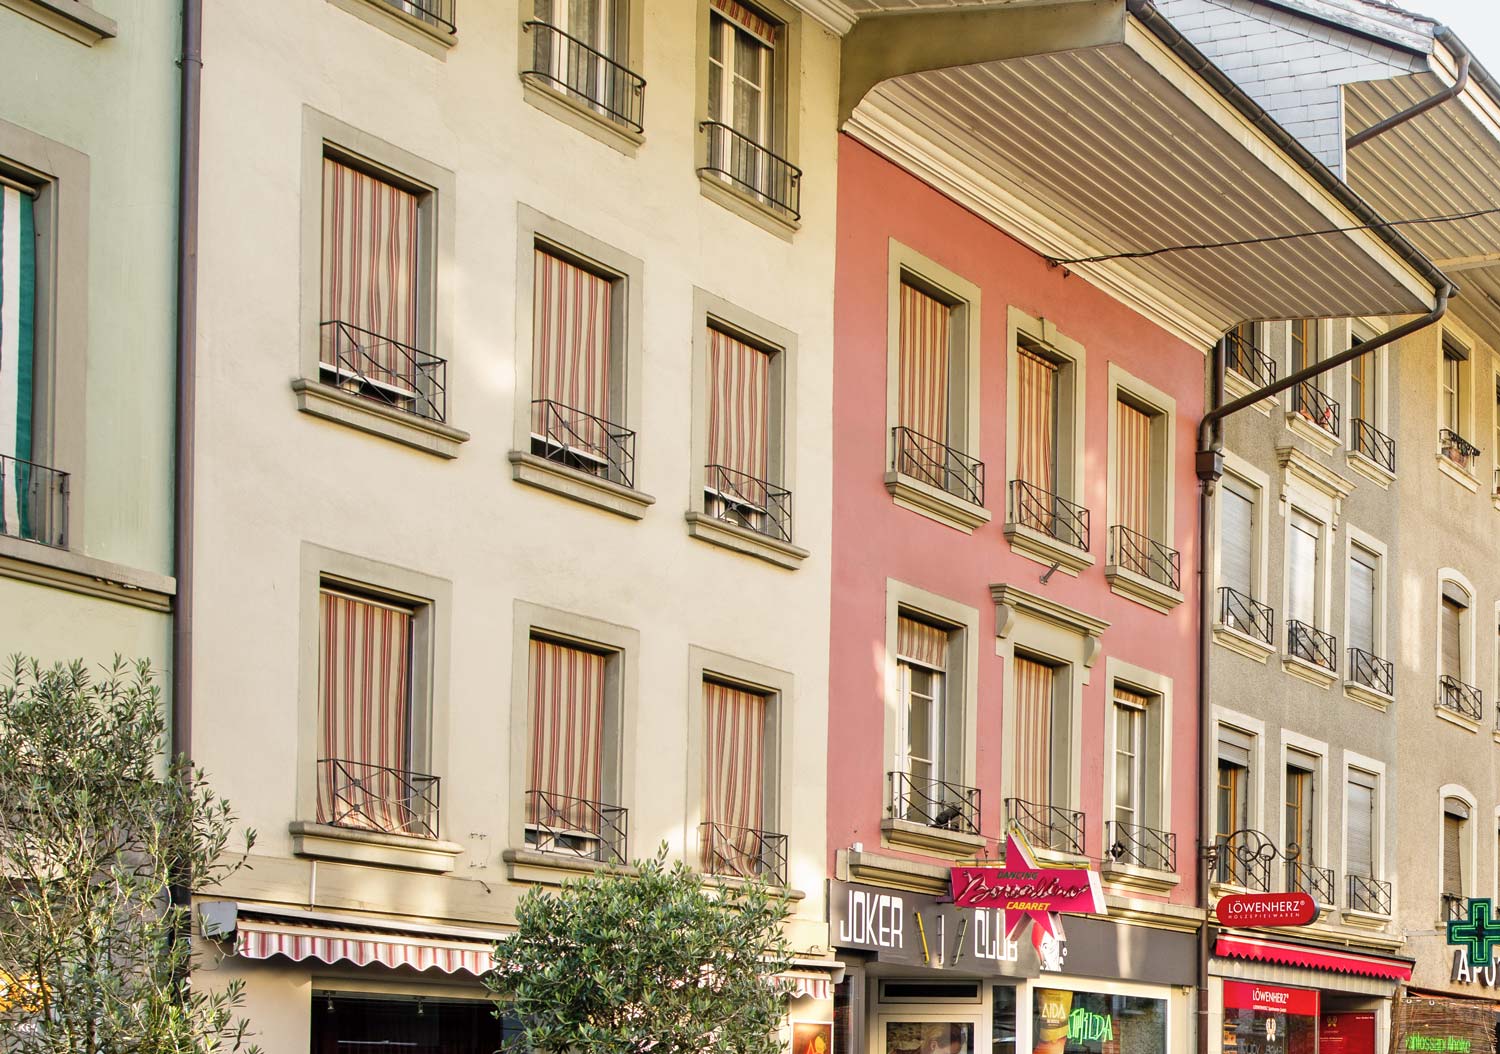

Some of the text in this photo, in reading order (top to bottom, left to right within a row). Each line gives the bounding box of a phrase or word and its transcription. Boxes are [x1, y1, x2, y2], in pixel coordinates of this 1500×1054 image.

[997, 871, 1039, 880] DANCING
[1005, 901, 1051, 911] CABARET
[840, 890, 904, 949] JOKER
[1042, 1002, 1066, 1019] AIDA
